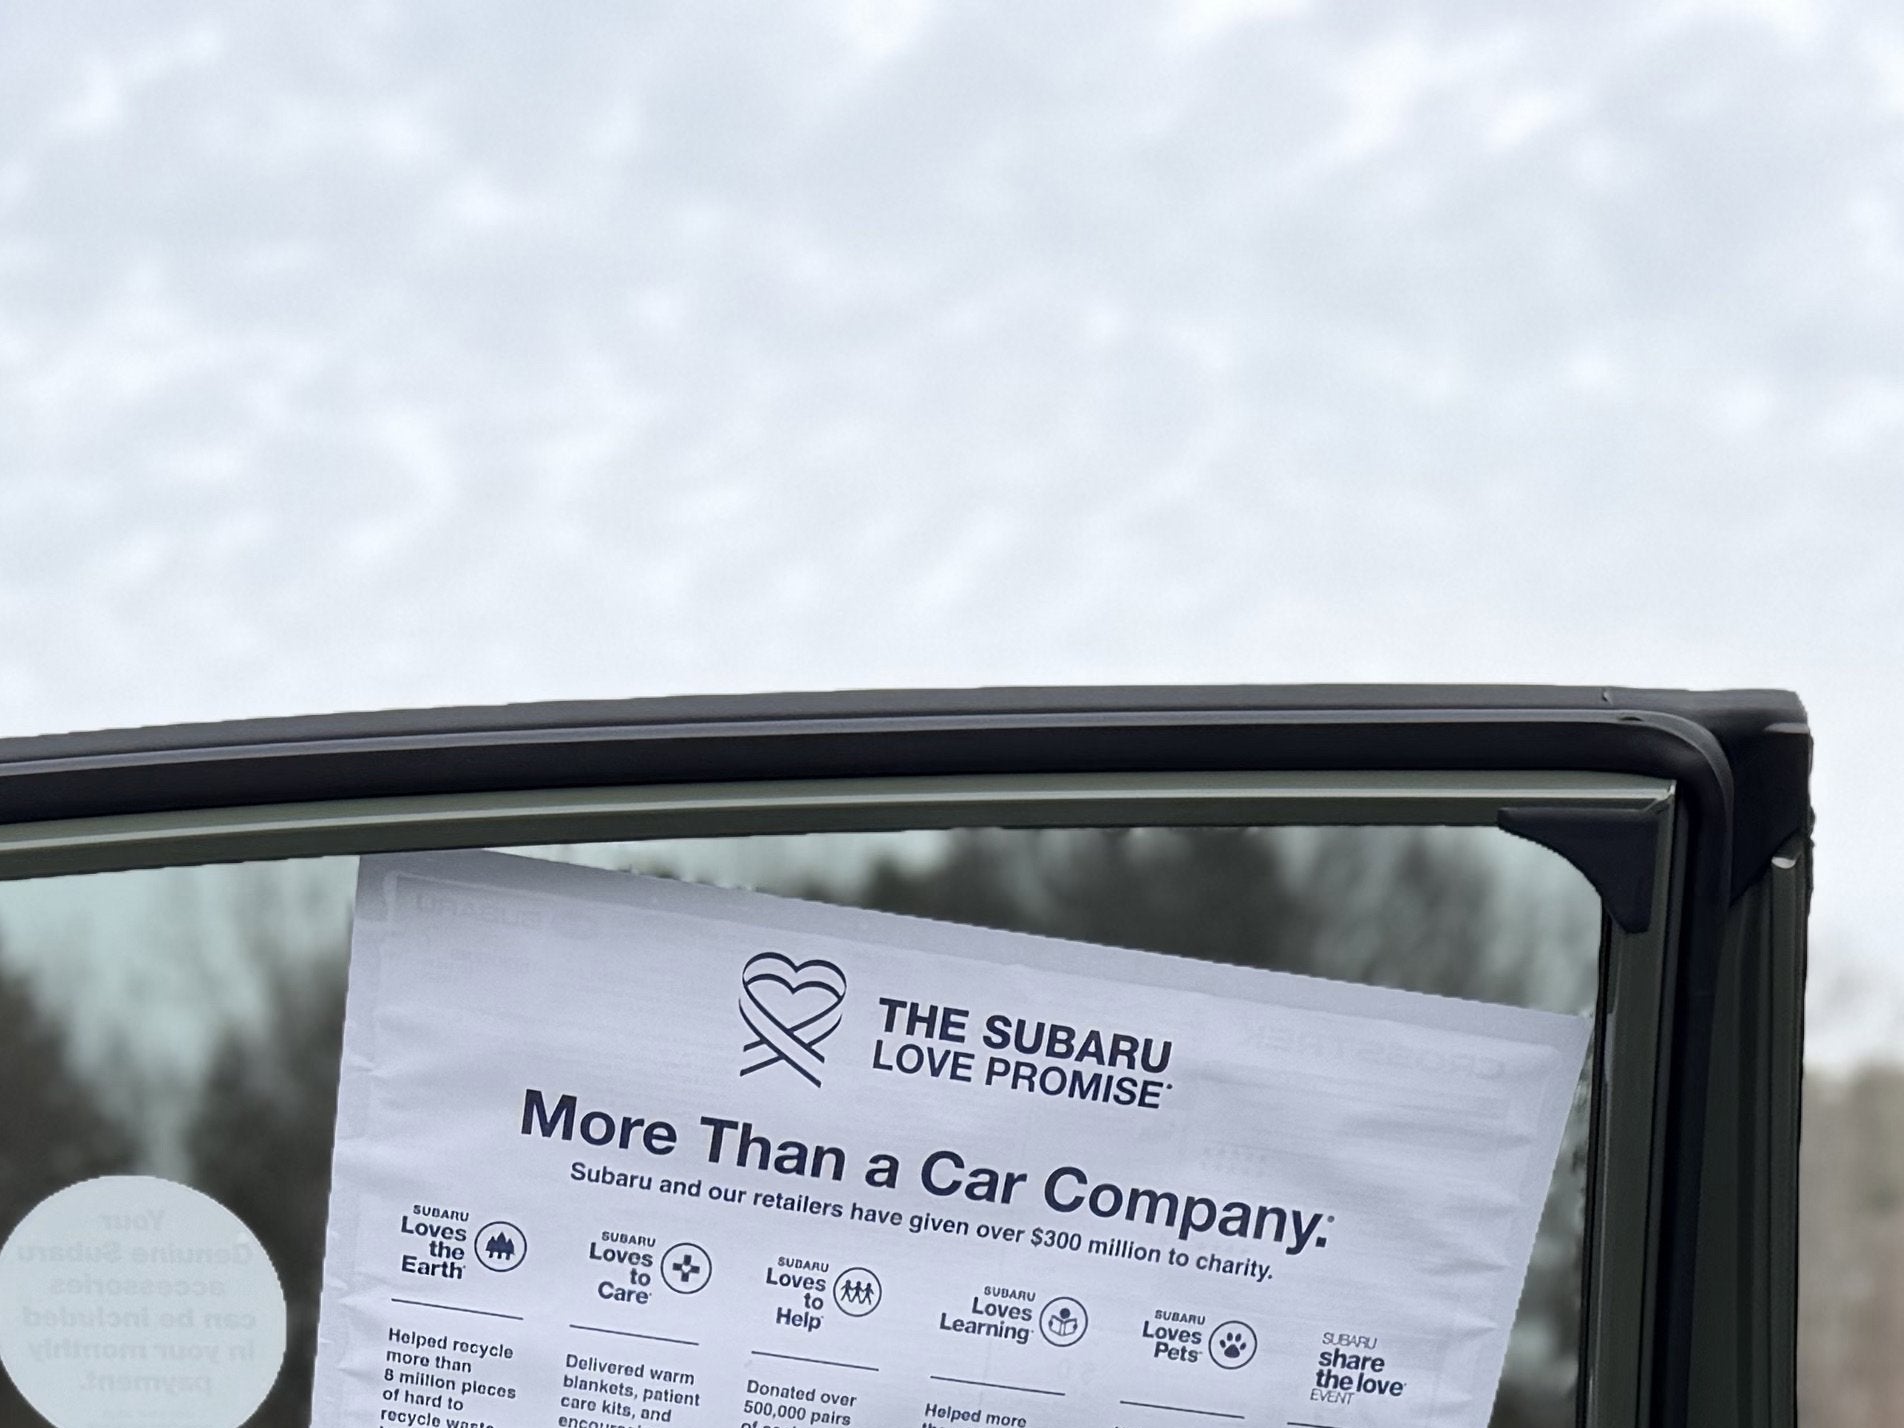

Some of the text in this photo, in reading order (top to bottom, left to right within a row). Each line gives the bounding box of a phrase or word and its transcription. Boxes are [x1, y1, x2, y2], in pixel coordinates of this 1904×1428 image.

[878, 997, 1172, 1074] THE SUBARU
[872, 1039, 1173, 1109] LOVE PROMISE
[521, 1088, 1334, 1255] More Than a Car Company.
[413, 1204, 469, 1222] SUBARU
[570, 1161, 1272, 1283] Subaru and our retailers have given over $300 million to charity.
[401, 1215, 467, 1242] Loves
[601, 1231, 656, 1248] SUBARU
[428, 1240, 465, 1260] the
[589, 1241, 653, 1268] Loves
[401, 1254, 466, 1280] Earth
[629, 1267, 651, 1287] to
[777, 1256, 829, 1273] SUBARU
[597, 1280, 652, 1304] Care
[765, 1266, 826, 1292] Loves
[803, 1292, 824, 1310] to
[983, 1285, 1036, 1302] SUBARU
[775, 1306, 824, 1331] Help
[971, 1296, 1032, 1321] Loves
[1154, 1309, 1206, 1325] SUBARU
[939, 1312, 1034, 1344] Learning
[1142, 1320, 1202, 1345] Loves
[1322, 1331, 1377, 1350] SUBARU
[388, 1327, 513, 1359] Helped recycle
[1153, 1341, 1203, 1363] Pets
[386, 1350, 471, 1373] more than
[565, 1353, 694, 1385] Delivered warm
[1318, 1347, 1385, 1373] share
[384, 1368, 516, 1399] 8 million pieces
[563, 1374, 700, 1406] blankets, patient
[746, 1379, 857, 1407] Donated over
[1315, 1368, 1406, 1397] the love
[382, 1388, 463, 1411] of hard to
[560, 1396, 672, 1422] care kits, and
[1310, 1388, 1354, 1404] EVENT
[380, 1409, 440, 1428] recycle
[743, 1399, 851, 1426] 500,000 pairs
[924, 1402, 1027, 1428] Helped more
